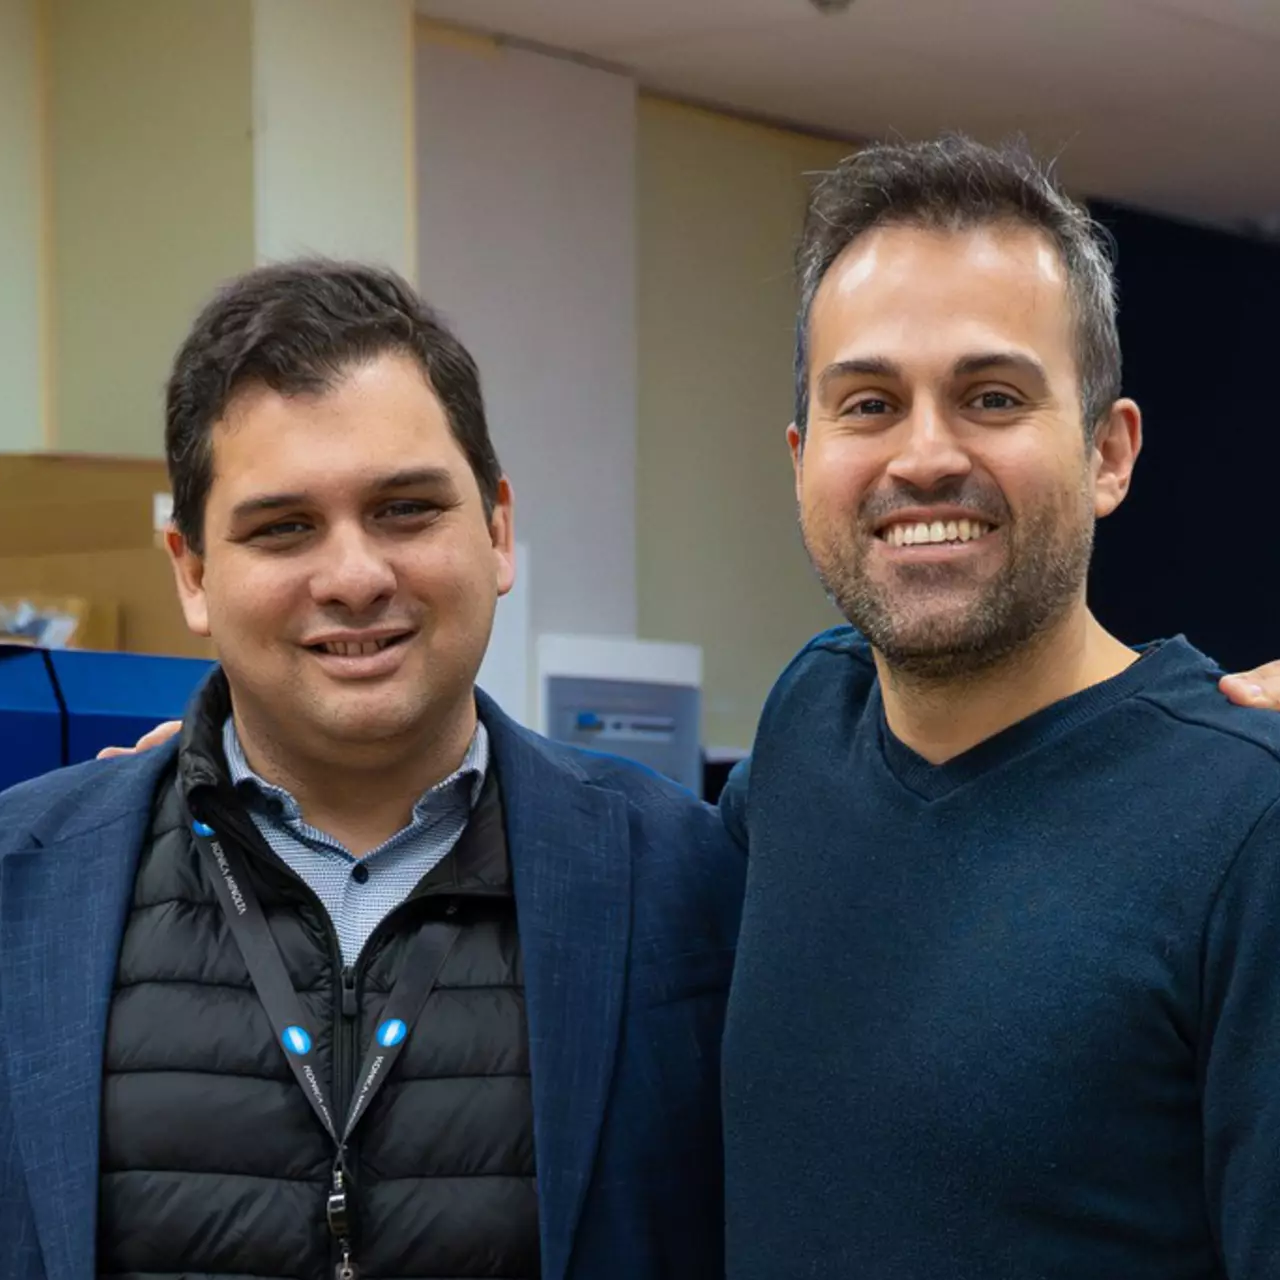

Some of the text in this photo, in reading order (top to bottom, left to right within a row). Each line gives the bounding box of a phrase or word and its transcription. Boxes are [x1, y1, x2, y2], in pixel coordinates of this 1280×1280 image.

[210, 841, 247, 916] KONICA MINOLTA
[361, 1056, 384, 1093] KONICA
